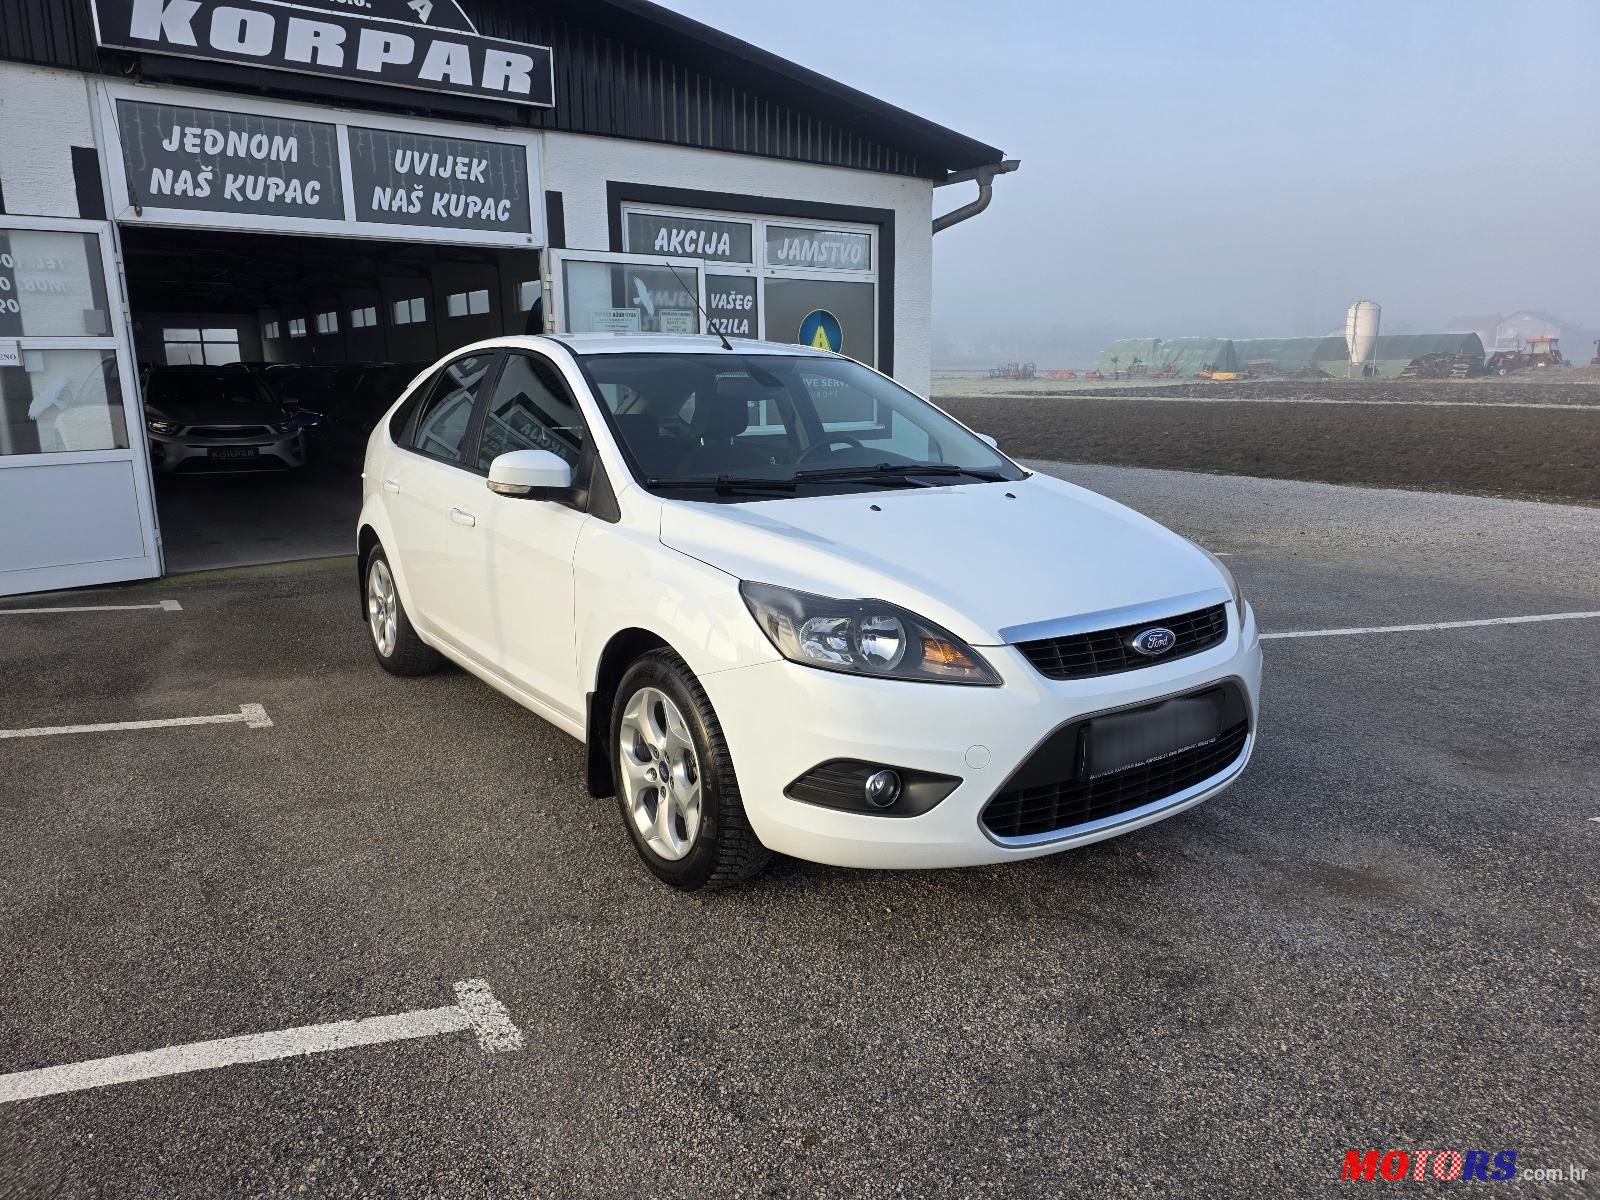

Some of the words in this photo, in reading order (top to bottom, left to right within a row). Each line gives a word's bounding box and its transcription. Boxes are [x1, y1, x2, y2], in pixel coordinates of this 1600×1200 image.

[130, 0, 533, 94] KORPAR
[163, 125, 298, 163] JEDNOM
[394, 149, 488, 184] UVIJEK
[150, 165, 213, 198] NAŠ
[224, 173, 321, 205] KUPAC
[371, 184, 424, 214] NAŠ
[431, 192, 511, 222] KUPAC
[654, 227, 730, 255] AKCIJA
[777, 238, 861, 263] JAMSTVO
[710, 290, 753, 310] VAŠEG
[1147, 633, 1168, 649] Ford
